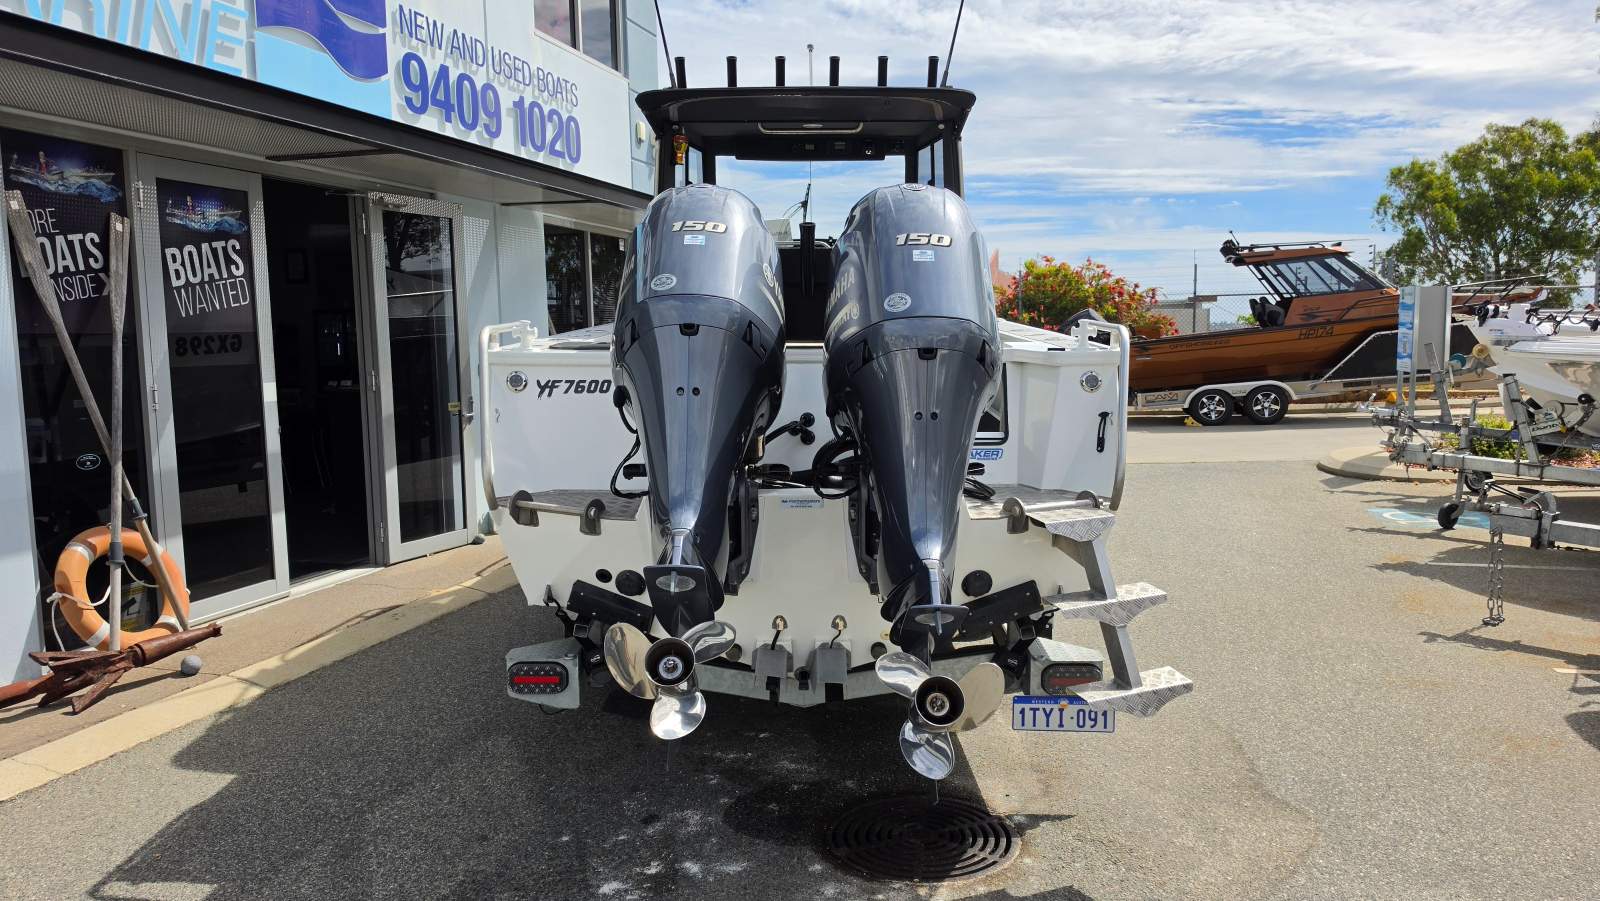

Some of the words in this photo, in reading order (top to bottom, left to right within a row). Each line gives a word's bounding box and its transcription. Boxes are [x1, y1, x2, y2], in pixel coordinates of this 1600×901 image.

[398, 3, 445, 50] NEW
[450, 28, 486, 68] AND
[491, 46, 532, 87] USED
[536, 66, 579, 107] BOATS
[401, 51, 503, 139] 9409
[513, 95, 582, 165] 1020
[671, 220, 727, 234] 150
[895, 232, 952, 247] 150
[34, 232, 105, 276] OATS
[165, 238, 245, 288] BOATS
[49, 273, 100, 302] NSIDE
[173, 277, 250, 318] WANTED
[536, 379, 612, 401] YF7600
